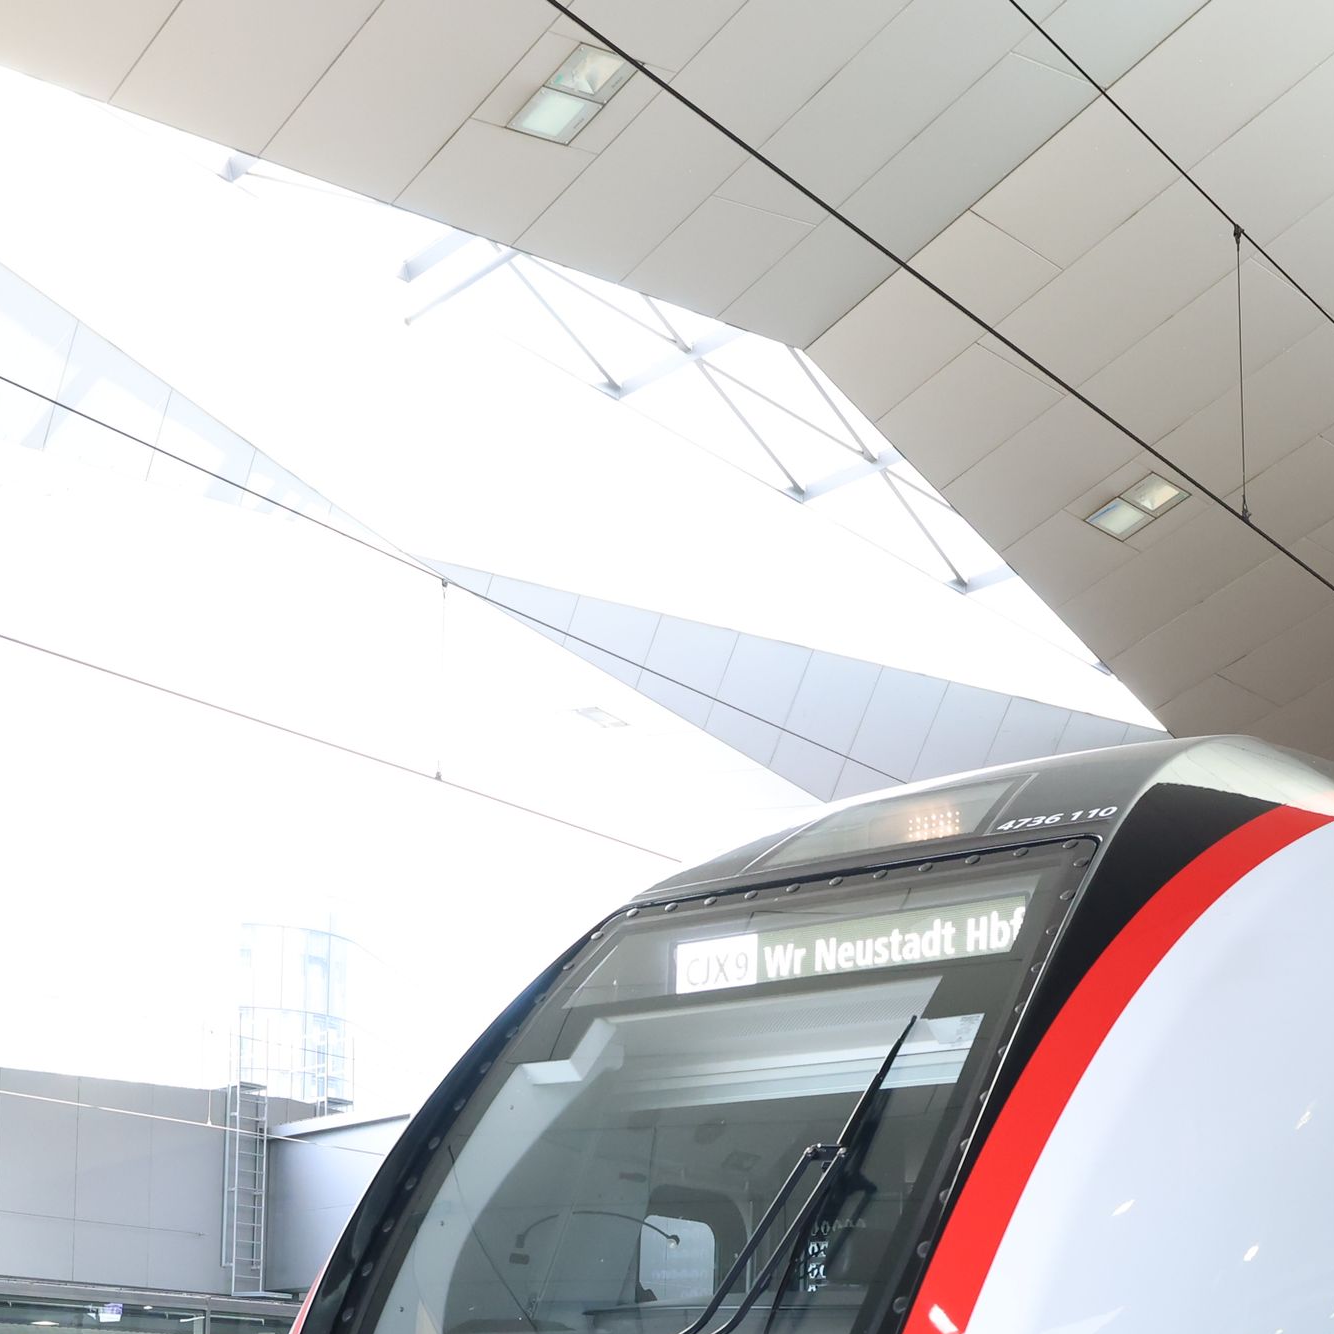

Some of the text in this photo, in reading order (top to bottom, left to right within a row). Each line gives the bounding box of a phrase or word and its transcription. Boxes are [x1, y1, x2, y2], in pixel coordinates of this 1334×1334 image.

[997, 806, 1118, 832] 4736 110
[764, 943, 806, 978] Wr
[814, 919, 955, 971] Neustadt
[966, 906, 1025, 952] Hbf
